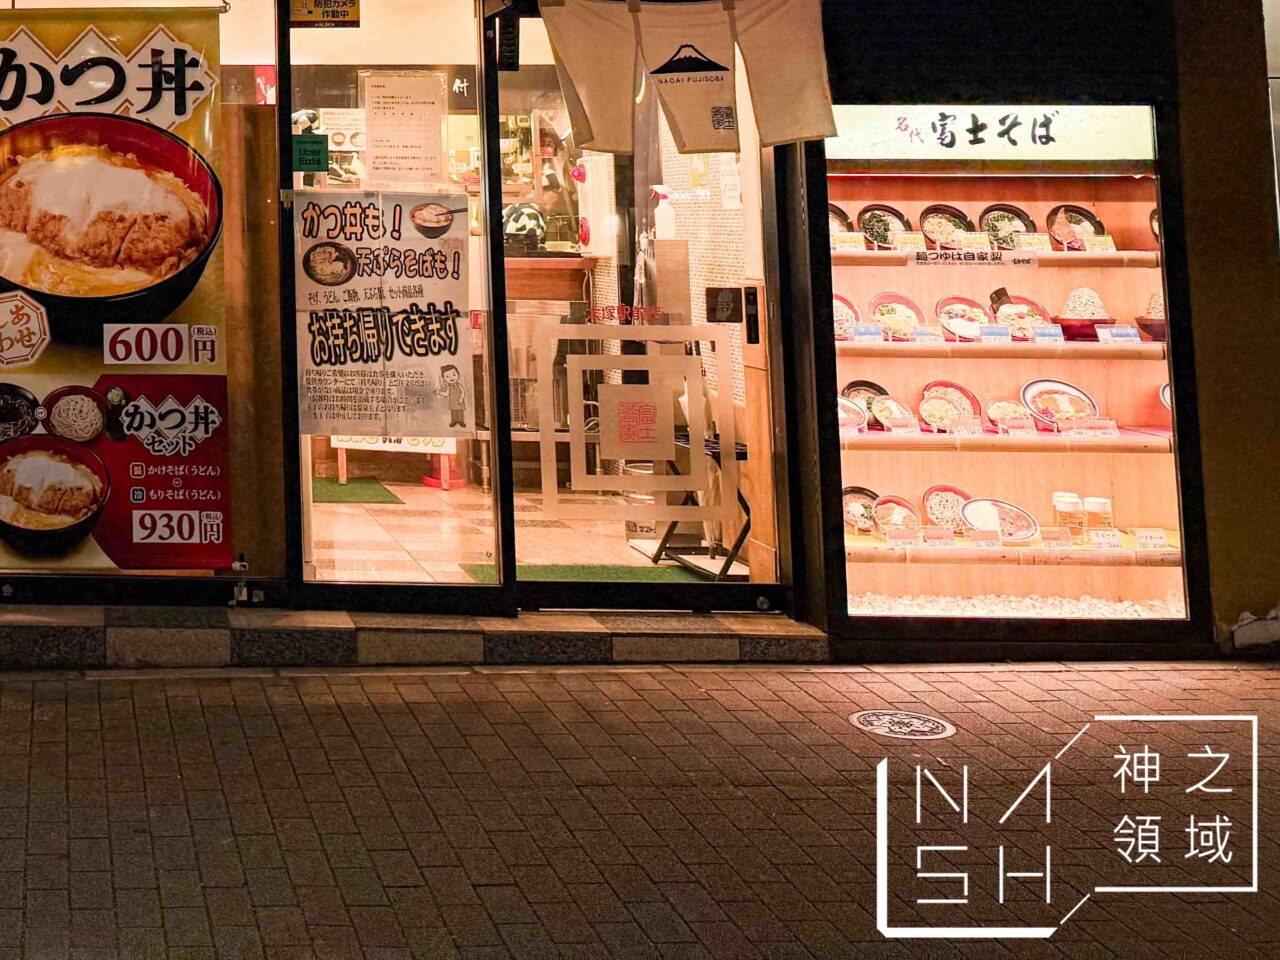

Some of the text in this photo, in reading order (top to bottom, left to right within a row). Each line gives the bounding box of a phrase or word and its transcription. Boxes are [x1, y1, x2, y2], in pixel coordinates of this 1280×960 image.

[313, 0, 356, 9] 防犯カメラ
[931, 110, 1060, 148] 富士そば
[108, 326, 184, 362] 600
[307, 301, 461, 367] お持ち帰りできます
[193, 339, 216, 363] 円
[124, 405, 218, 434] かつ丼
[145, 436, 195, 454] セット
[139, 513, 195, 540] 930
[203, 522, 221, 542] 円
